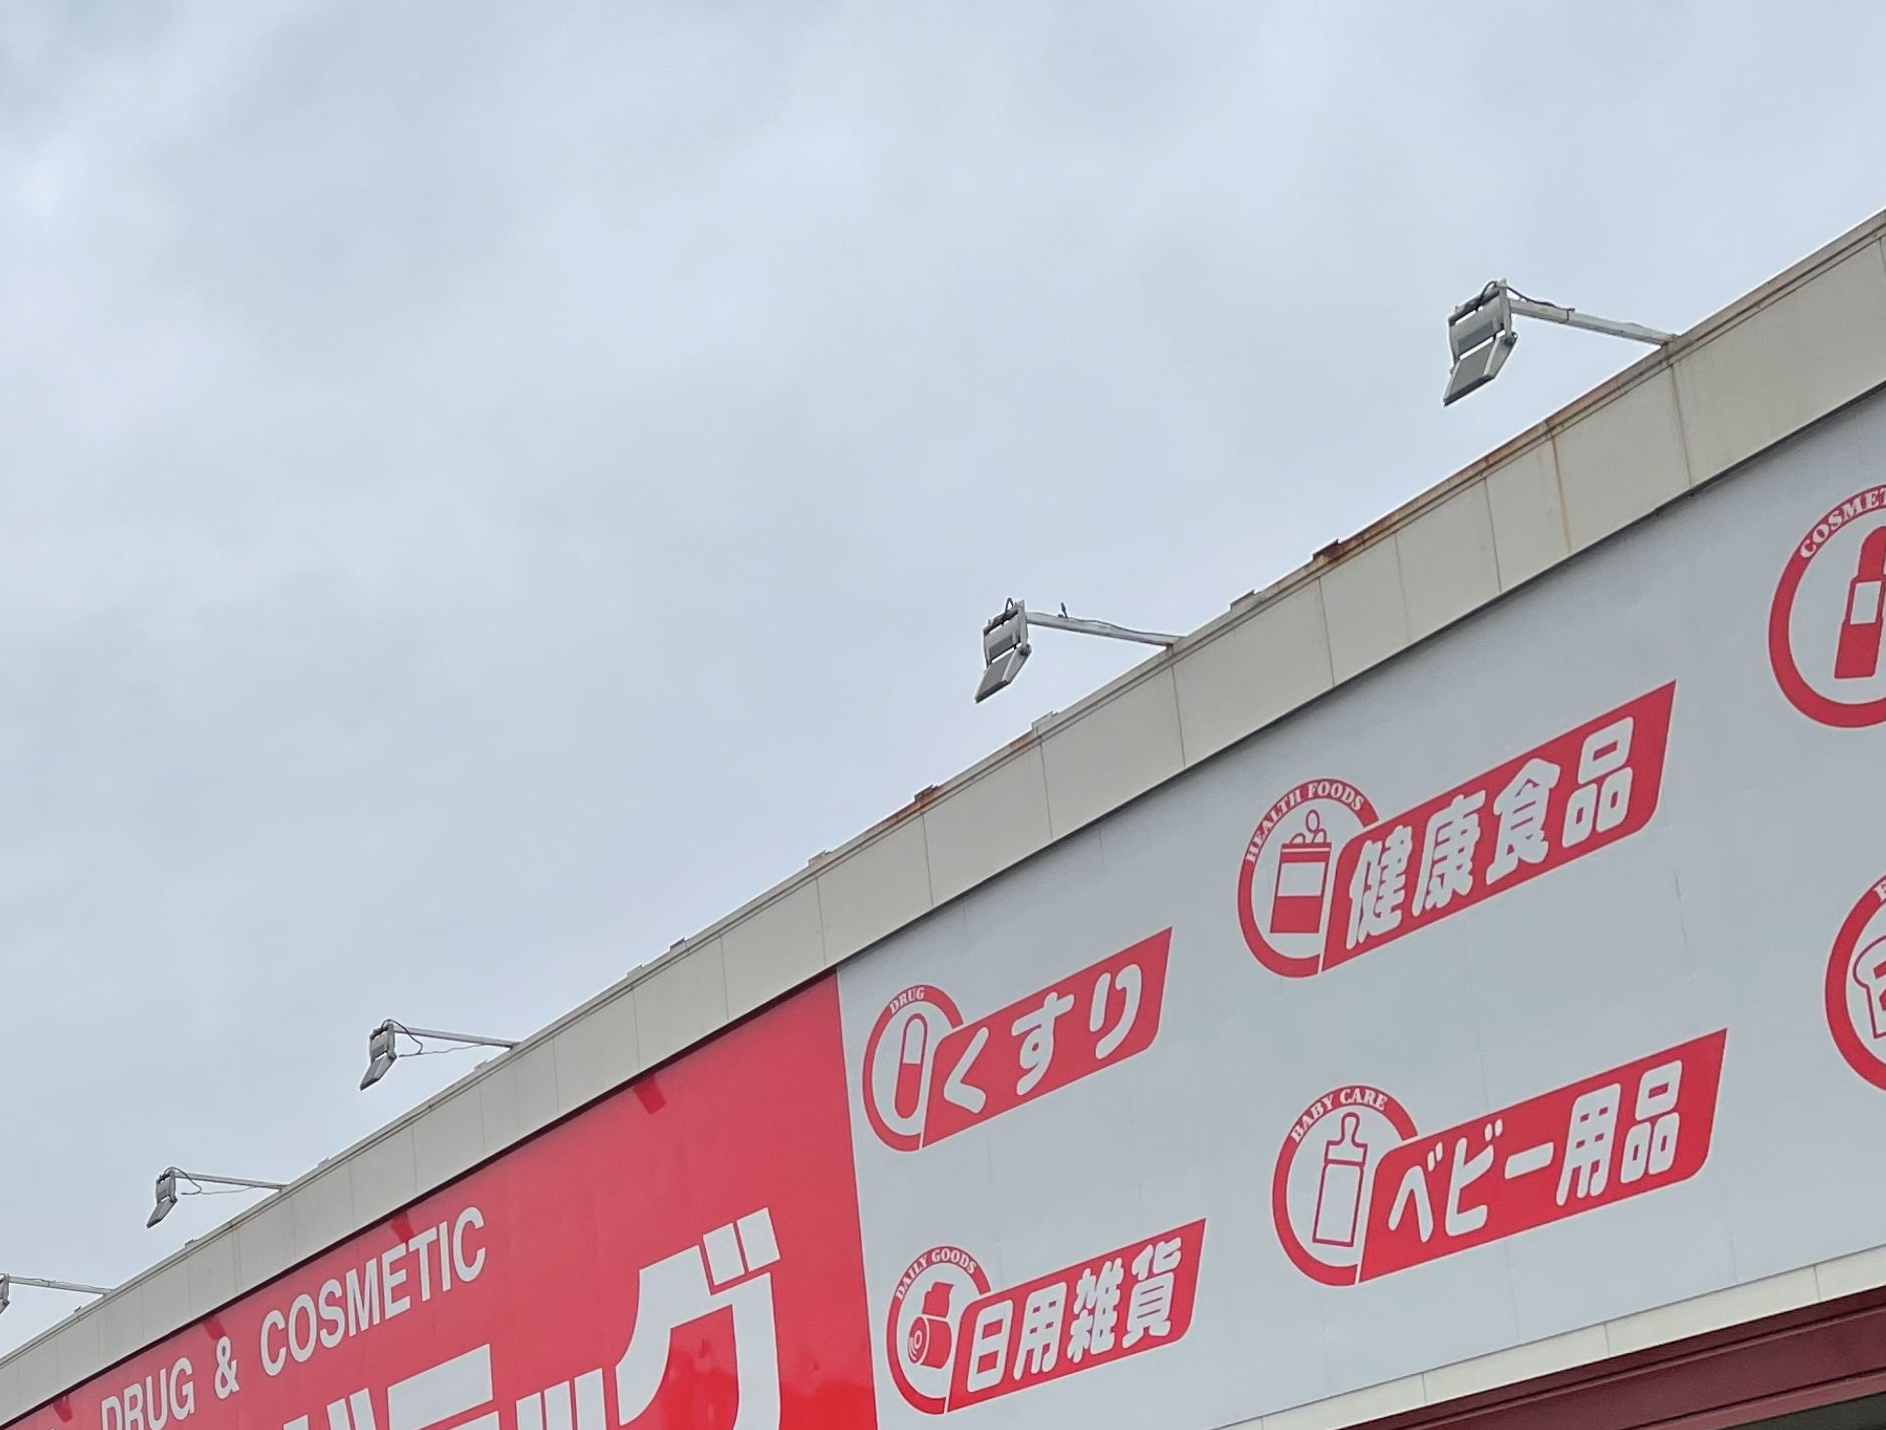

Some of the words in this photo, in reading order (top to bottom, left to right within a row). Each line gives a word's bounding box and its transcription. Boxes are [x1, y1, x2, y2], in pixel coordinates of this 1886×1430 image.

[1245, 789, 1302, 863] HEALTH
[1307, 781, 1364, 811] FOODS
[1346, 716, 1634, 950] 健康食品
[889, 986, 925, 1015] DRUG
[943, 964, 1142, 1114] くすり
[1290, 1094, 1334, 1143] BABY
[1339, 1088, 1388, 1111] CARE
[1389, 1060, 1683, 1243] ベビー用品
[214, 1336, 240, 1399] &
[260, 1206, 487, 1376] COSMETIC
[895, 1254, 928, 1300] DAILY
[931, 1247, 976, 1274] GOODS
[967, 1237, 1182, 1393] 日用雑貨
